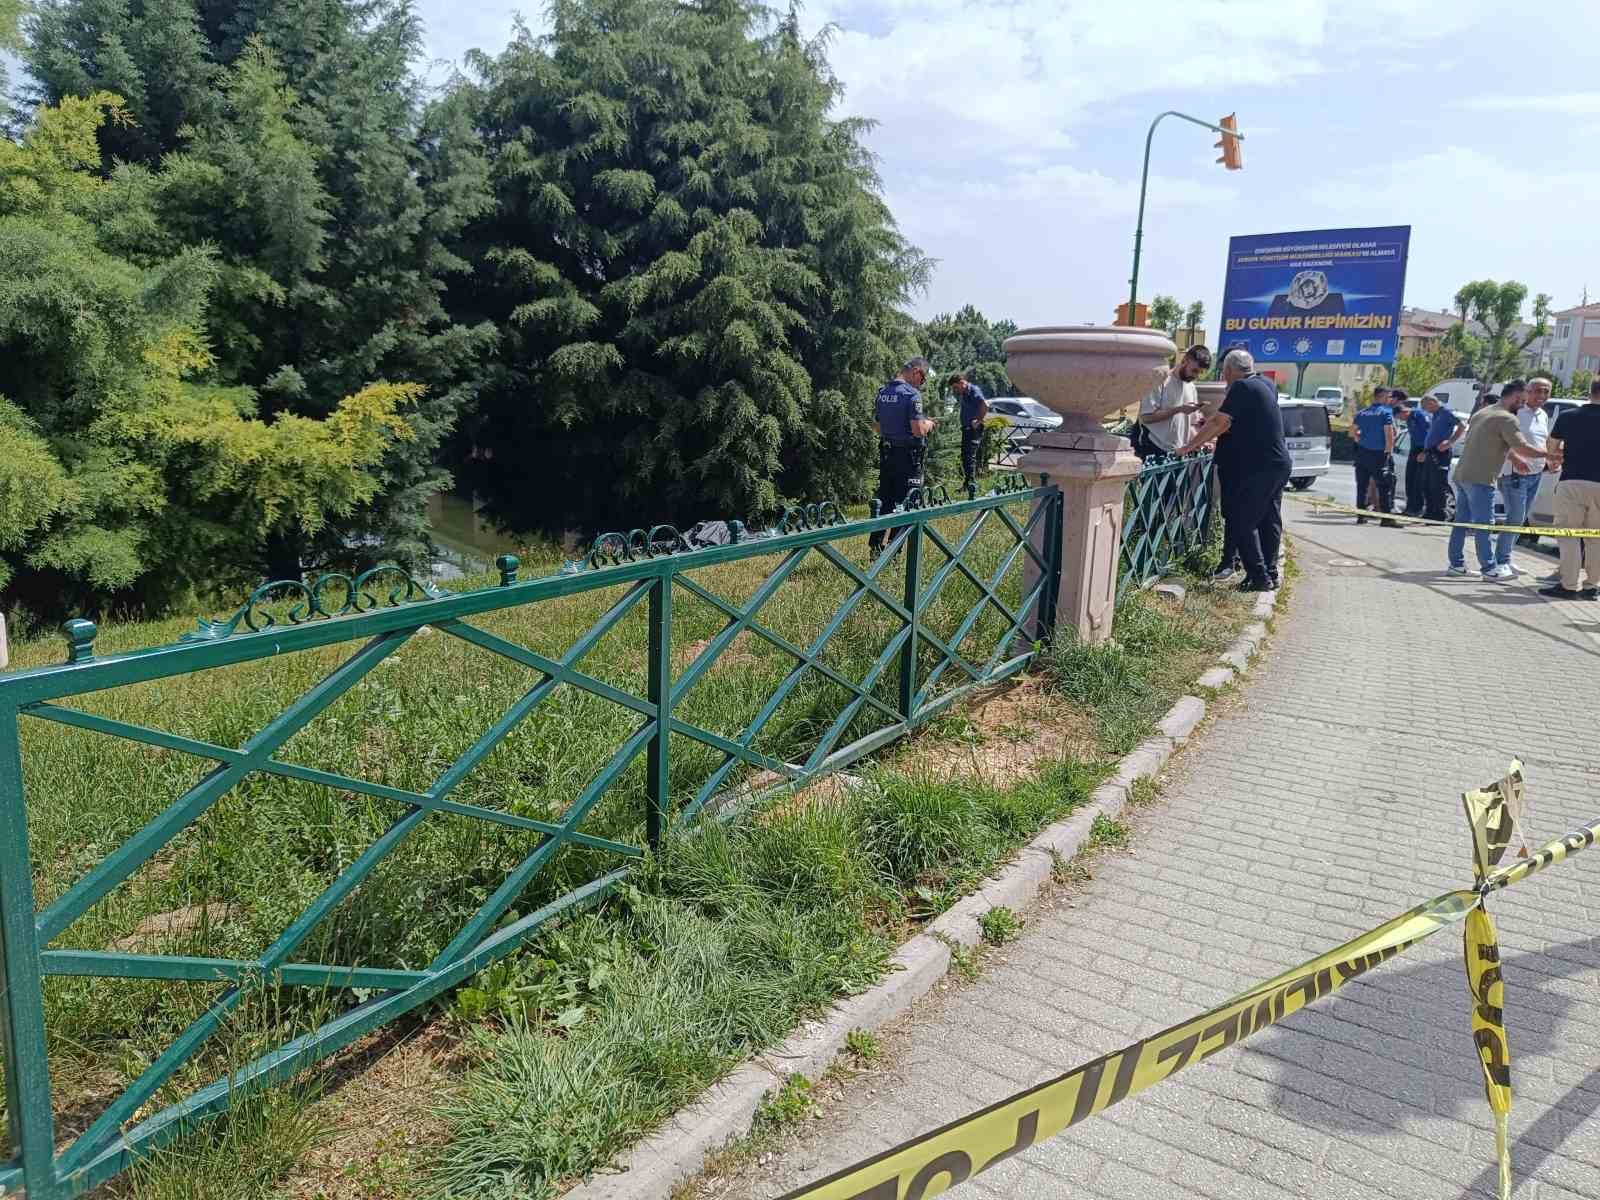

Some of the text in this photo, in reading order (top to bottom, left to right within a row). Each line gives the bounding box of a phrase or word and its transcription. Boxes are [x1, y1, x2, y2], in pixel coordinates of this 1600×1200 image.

[1225, 312, 1393, 331] BU GURUR HEPİMİZİN!
